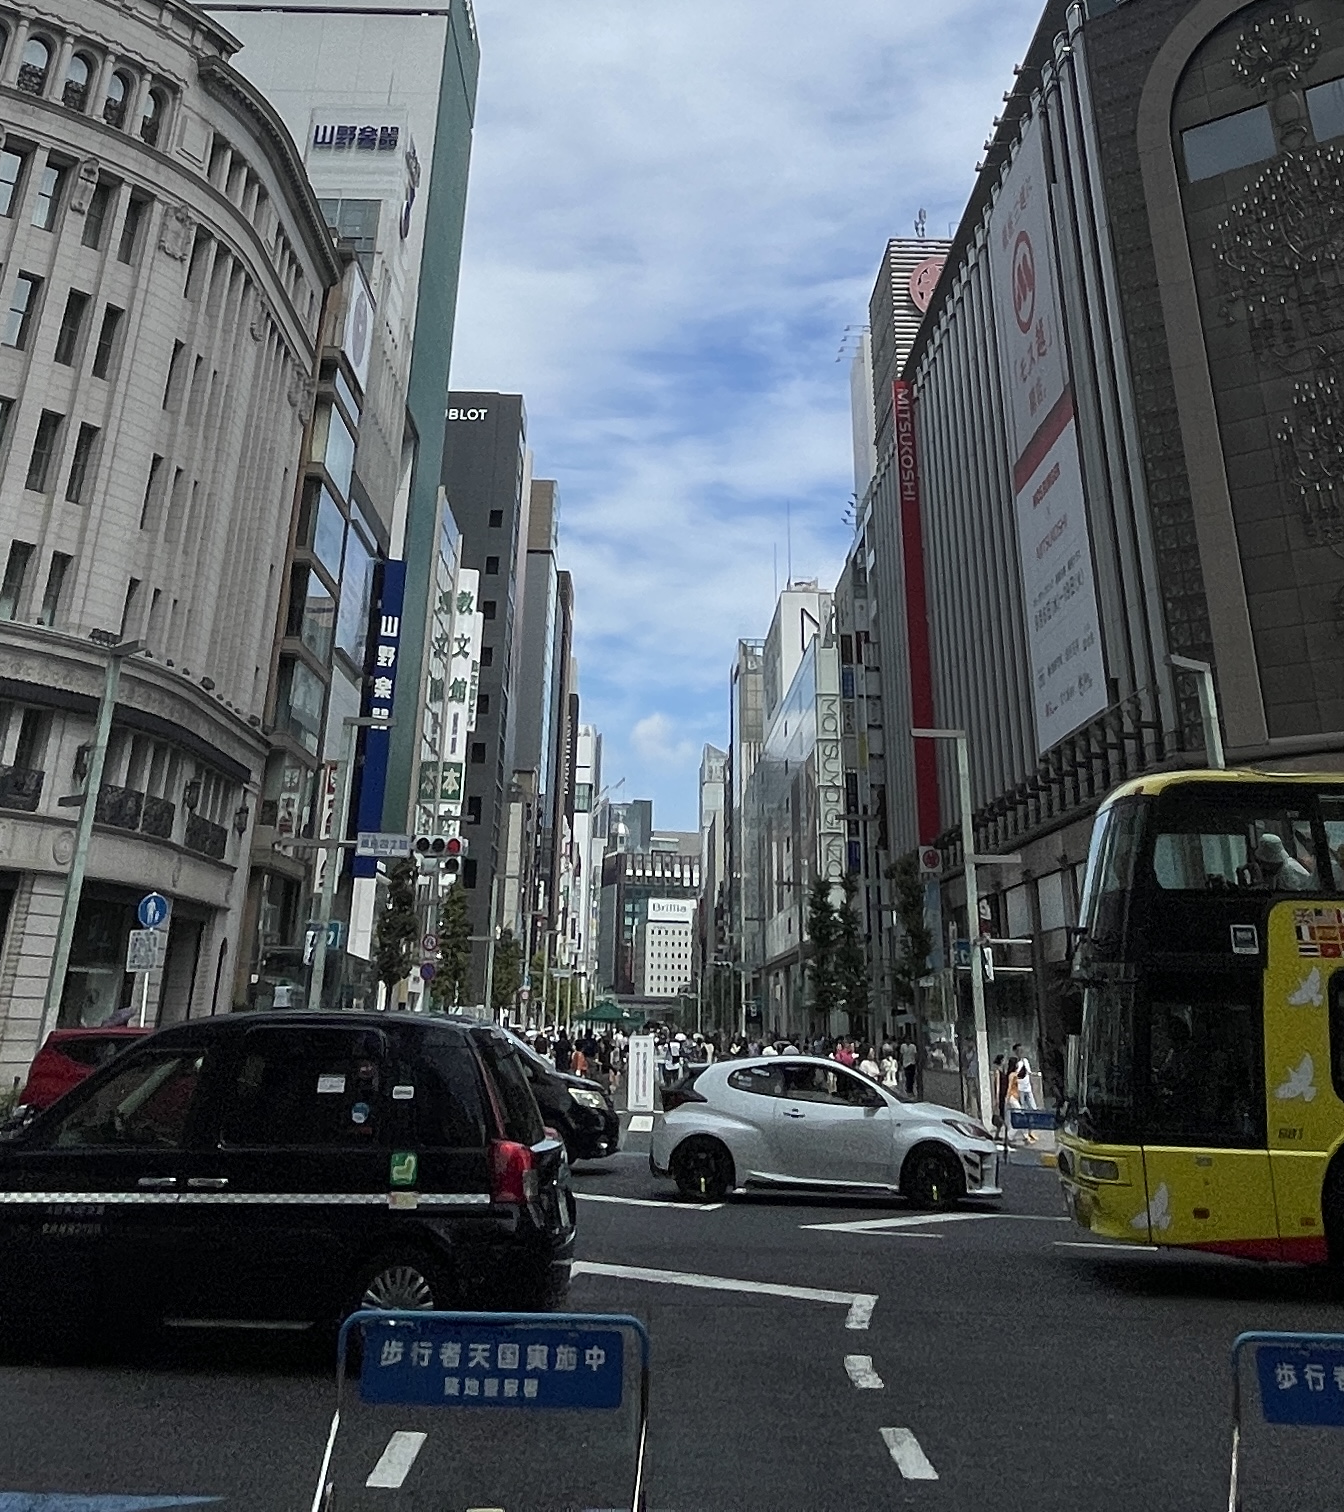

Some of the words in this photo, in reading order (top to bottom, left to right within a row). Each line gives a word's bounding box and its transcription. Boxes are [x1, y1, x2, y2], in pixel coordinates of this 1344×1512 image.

[313, 125, 399, 150] 山野楽器
[445, 408, 488, 421] BLOT
[896, 388, 916, 502] MITSUKOSHI
[448, 589, 474, 703] 教文館
[652, 902, 687, 913] Brillia
[380, 1340, 606, 1372] 歩行者天国実施中
